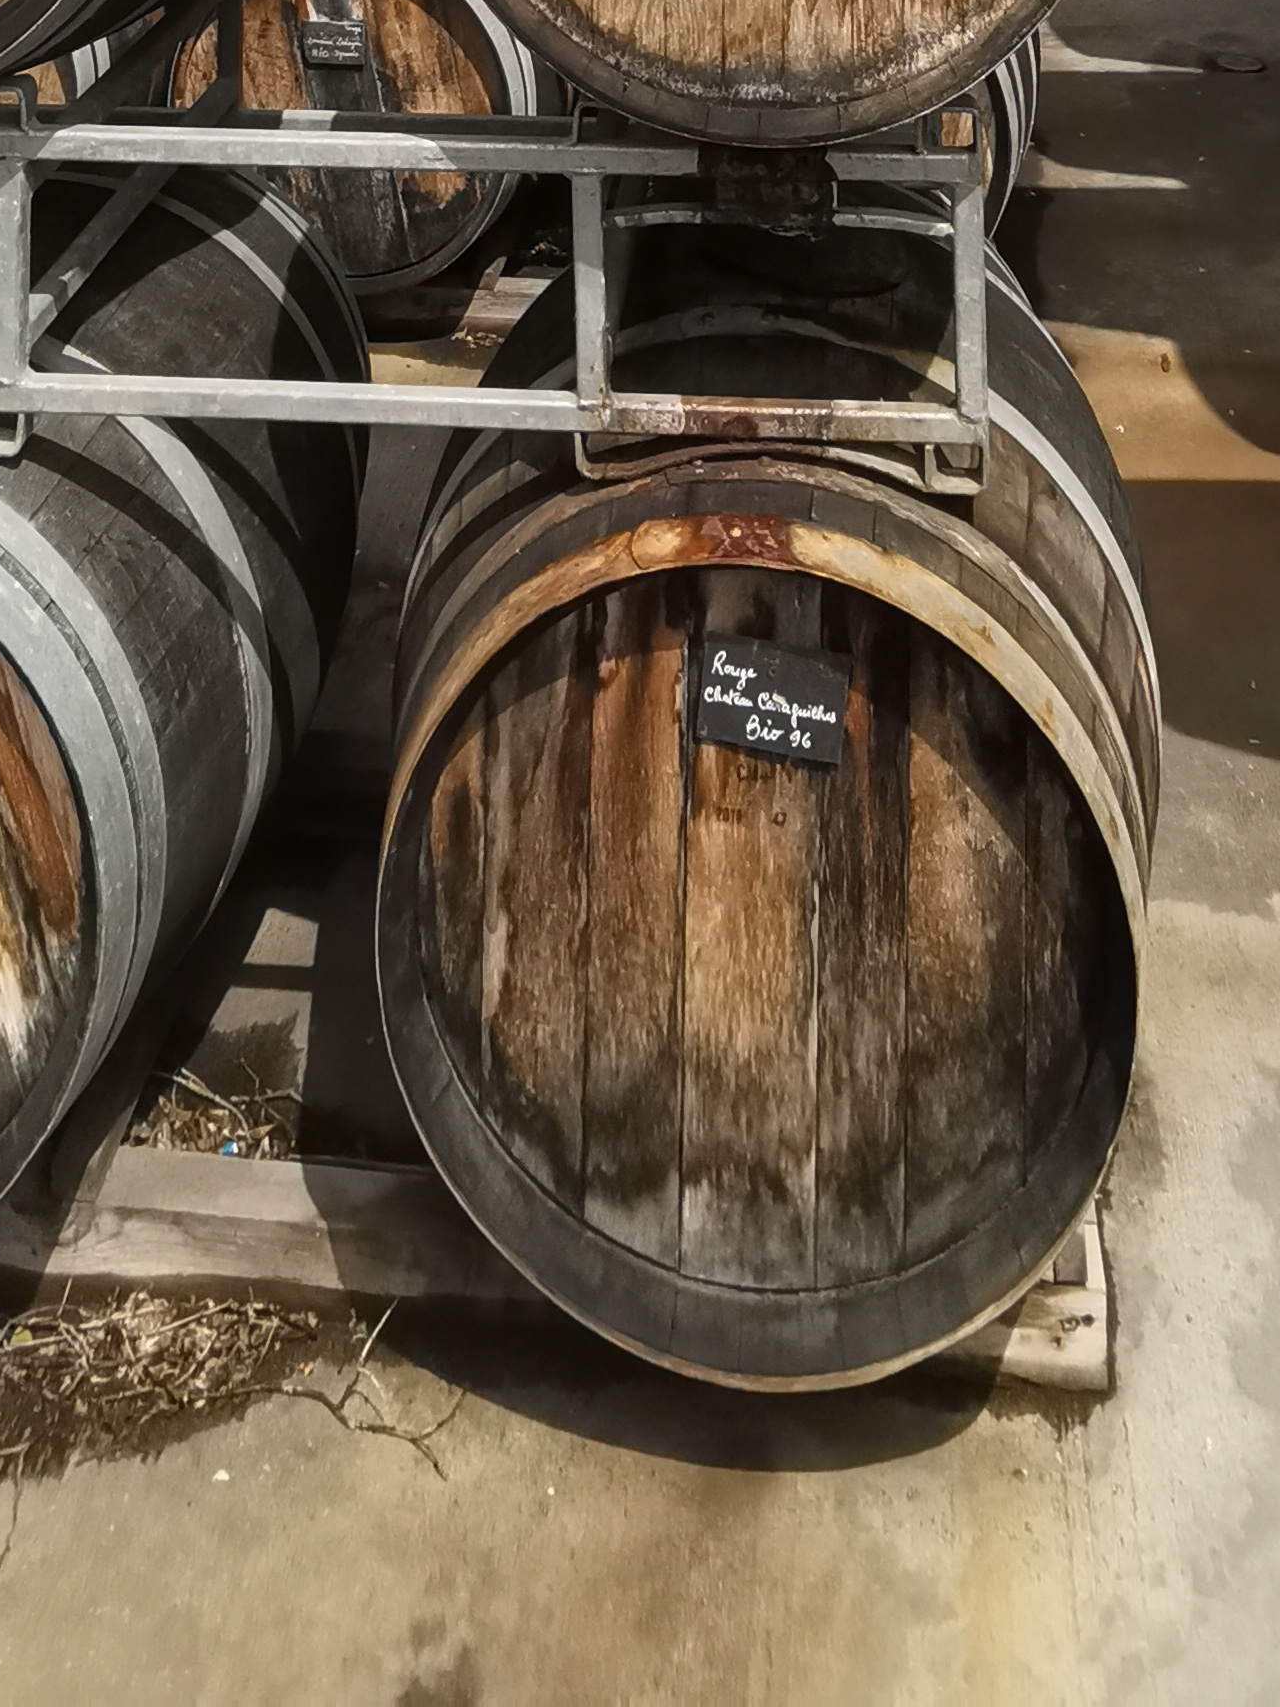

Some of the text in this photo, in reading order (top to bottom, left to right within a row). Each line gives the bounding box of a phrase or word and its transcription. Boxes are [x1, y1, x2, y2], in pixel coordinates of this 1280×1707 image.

[711, 650, 757, 690] Rouge
[746, 714, 812, 748] Bio 96
